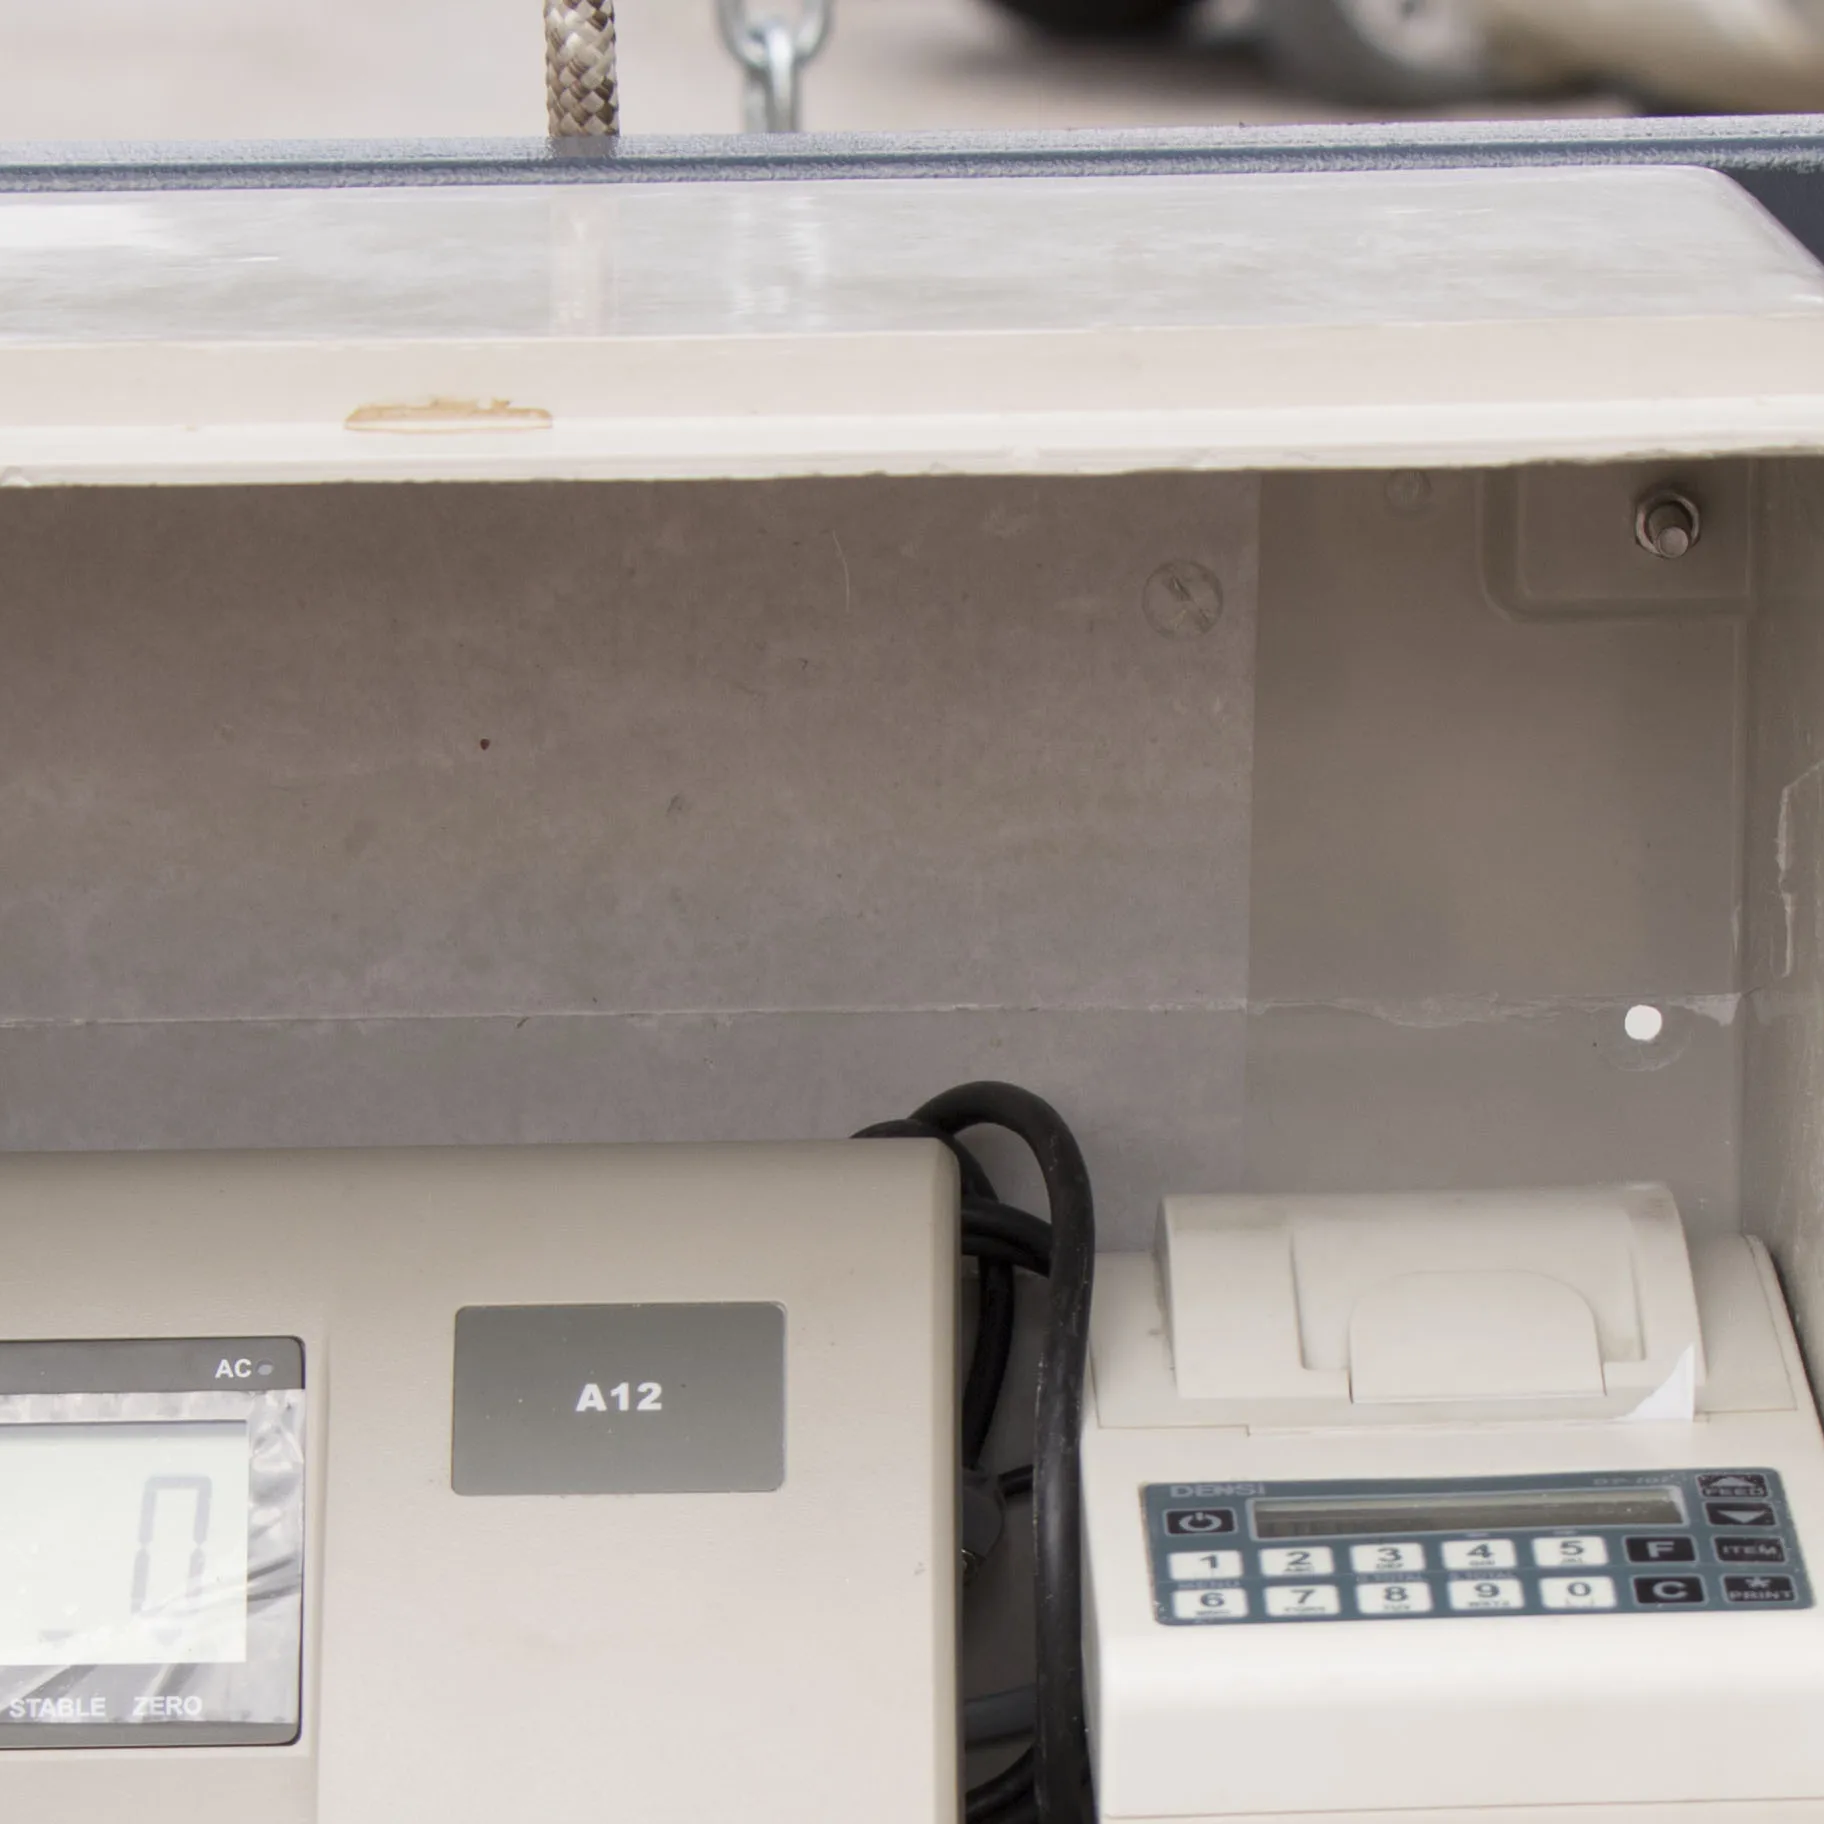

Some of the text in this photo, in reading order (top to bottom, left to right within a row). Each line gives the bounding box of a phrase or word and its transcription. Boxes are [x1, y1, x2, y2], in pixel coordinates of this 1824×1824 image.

[215, 1360, 252, 1379] AC
[576, 1382, 662, 1411] A12
[1378, 1547, 1402, 1562] 3
[1466, 1543, 1493, 1558] 4
[1560, 1540, 1584, 1556] 5
[1647, 1541, 1674, 1558] F
[1723, 1544, 1775, 1555] ITEM
[1200, 1555, 1218, 1569] 1
[1287, 1551, 1312, 1566] 2
[1291, 1589, 1315, 1604] 7
[1384, 1586, 1408, 1602] 8
[1475, 1583, 1499, 1598] 9
[1567, 1582, 1591, 1597] 0
[1652, 1581, 1688, 1598] C
[1729, 1590, 1793, 1600] PRINT
[1200, 1593, 1225, 1607] 6
[10, 1698, 106, 1718] STABLE
[133, 1697, 203, 1717] ZERO
